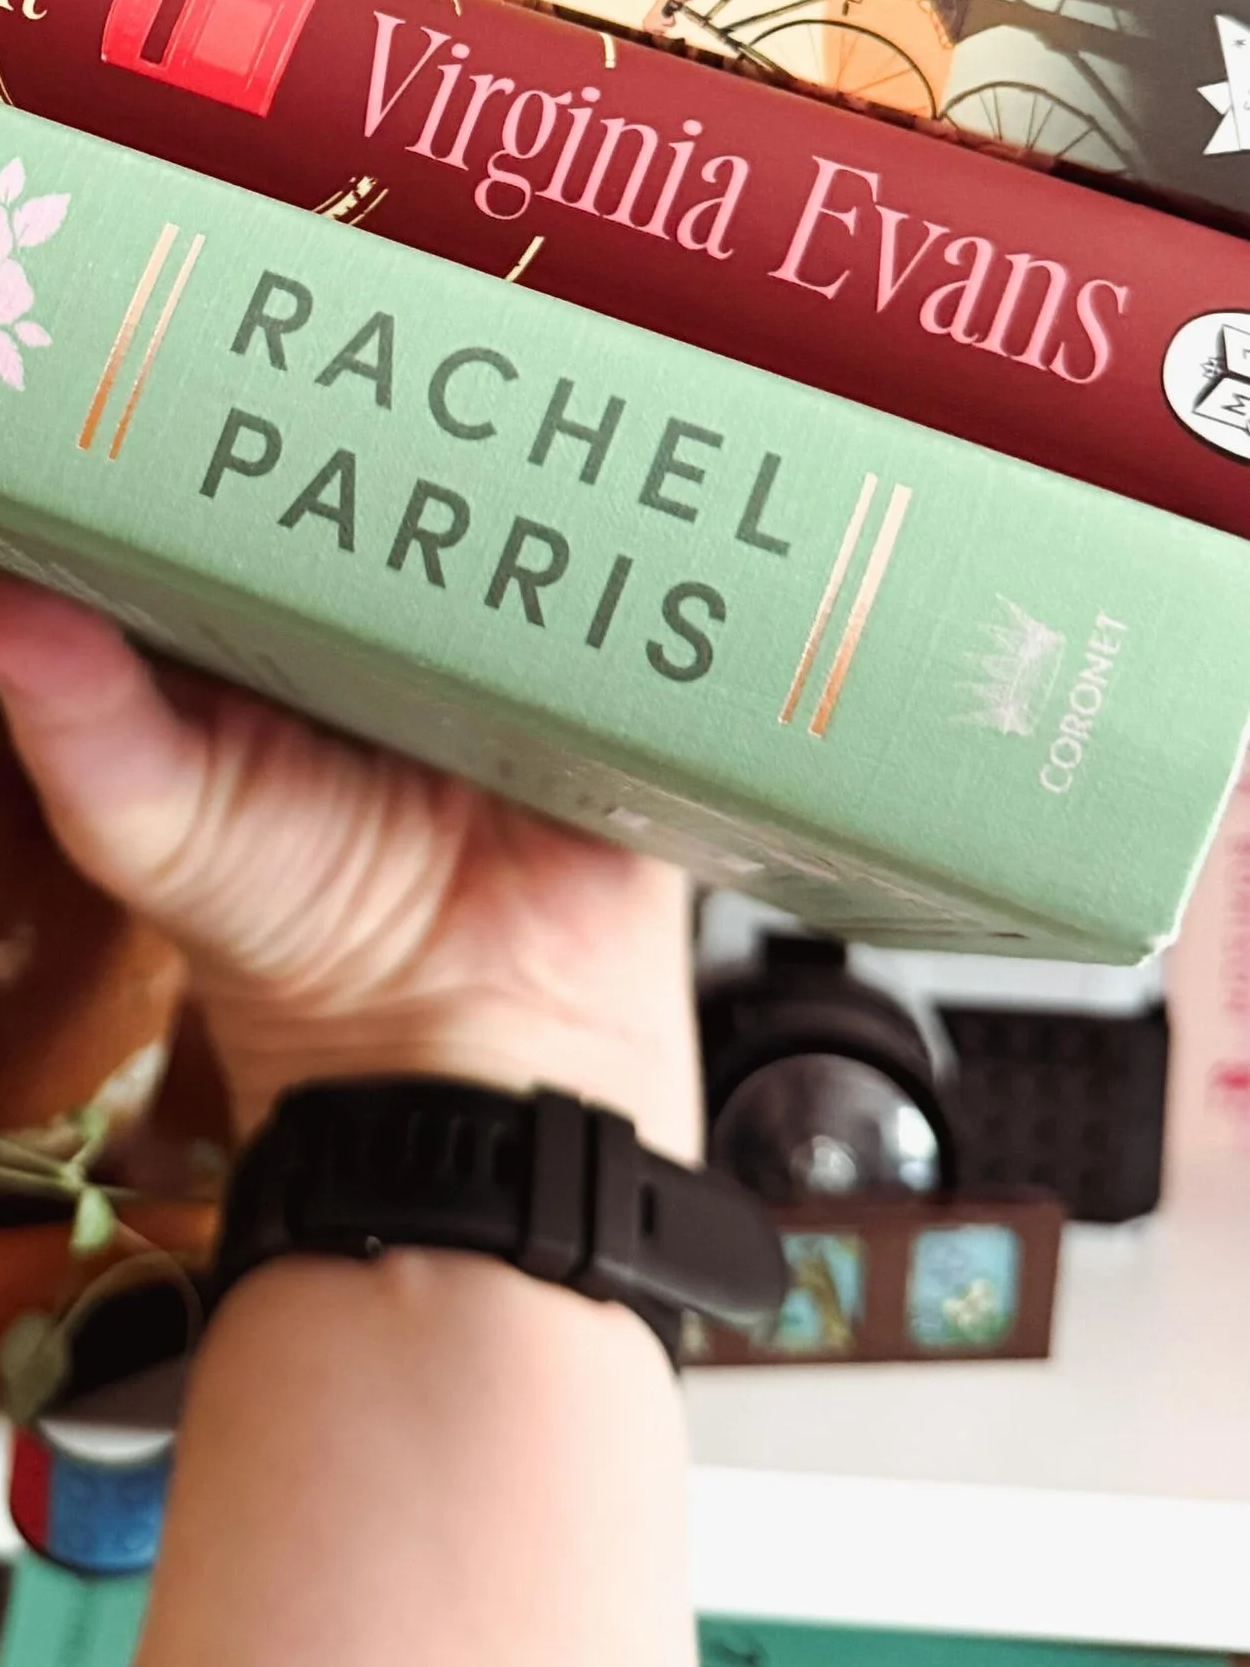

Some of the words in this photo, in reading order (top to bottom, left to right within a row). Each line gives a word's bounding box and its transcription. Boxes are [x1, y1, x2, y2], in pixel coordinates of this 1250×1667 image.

[363, 11, 750, 262] Virginia
[769, 155, 1131, 386] Evans
[198, 407, 728, 682] PARRIS
[228, 269, 794, 556] RACHEL
[1039, 609, 1129, 794] CORONET
